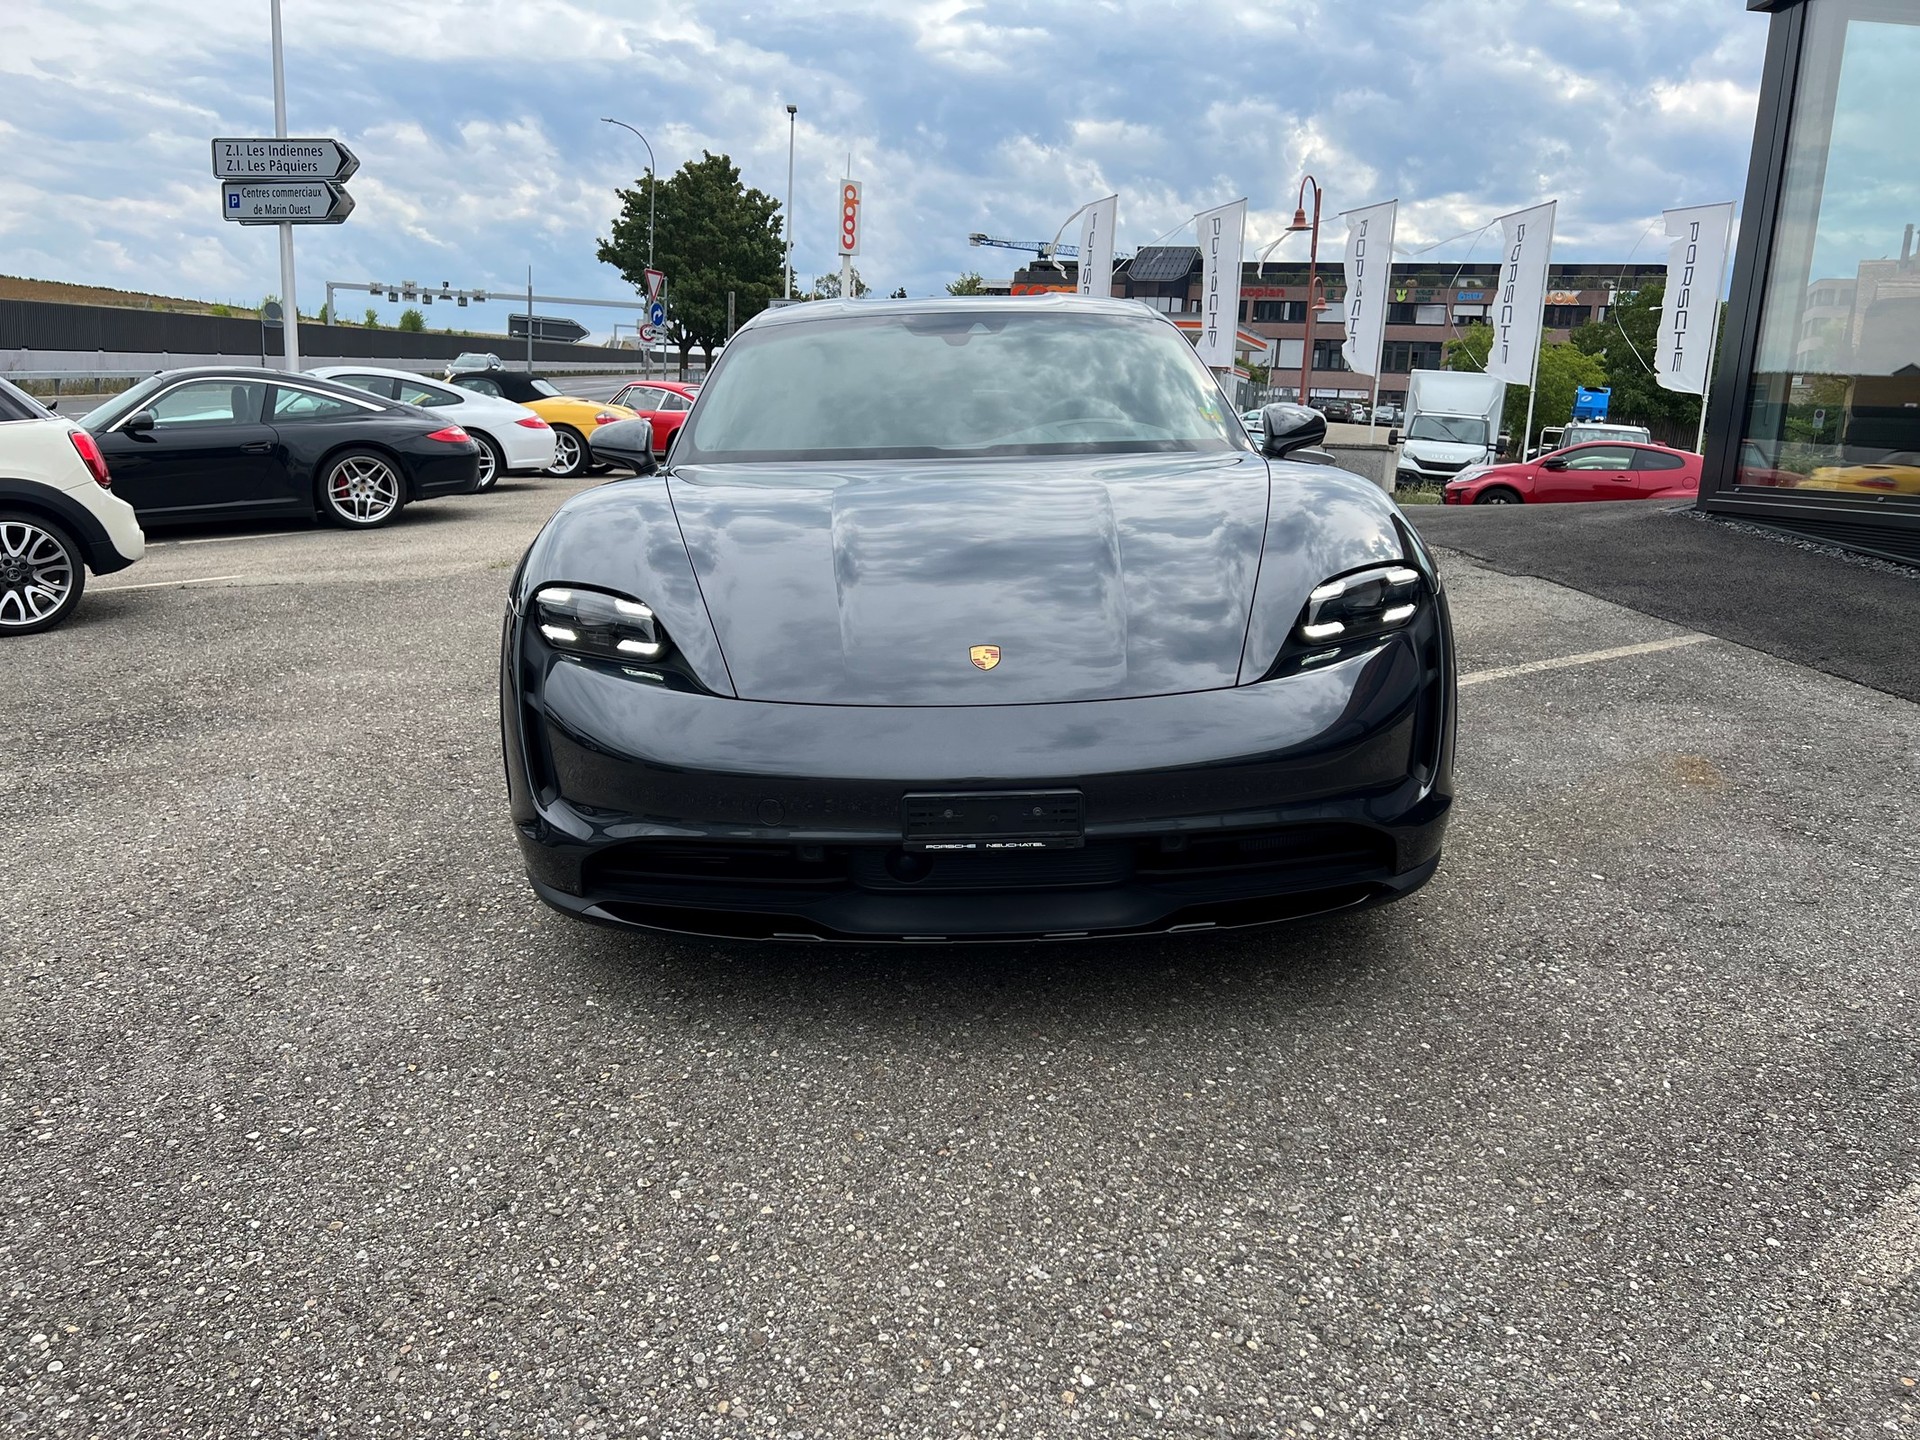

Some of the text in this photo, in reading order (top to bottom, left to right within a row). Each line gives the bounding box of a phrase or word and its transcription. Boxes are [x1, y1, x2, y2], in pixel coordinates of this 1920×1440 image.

[225, 144, 323, 157] Z.I. Les Indiennes
[226, 159, 318, 174] Z.I. Les Pâquiers
[241, 186, 322, 198] Centres commerciaux
[231, 195, 238, 207] P
[253, 203, 311, 215] de Marin Ouest
[842, 184, 860, 250] coop
[1671, 221, 1700, 372] PORSCHE
[1431, 453, 1455, 461] IVECO
